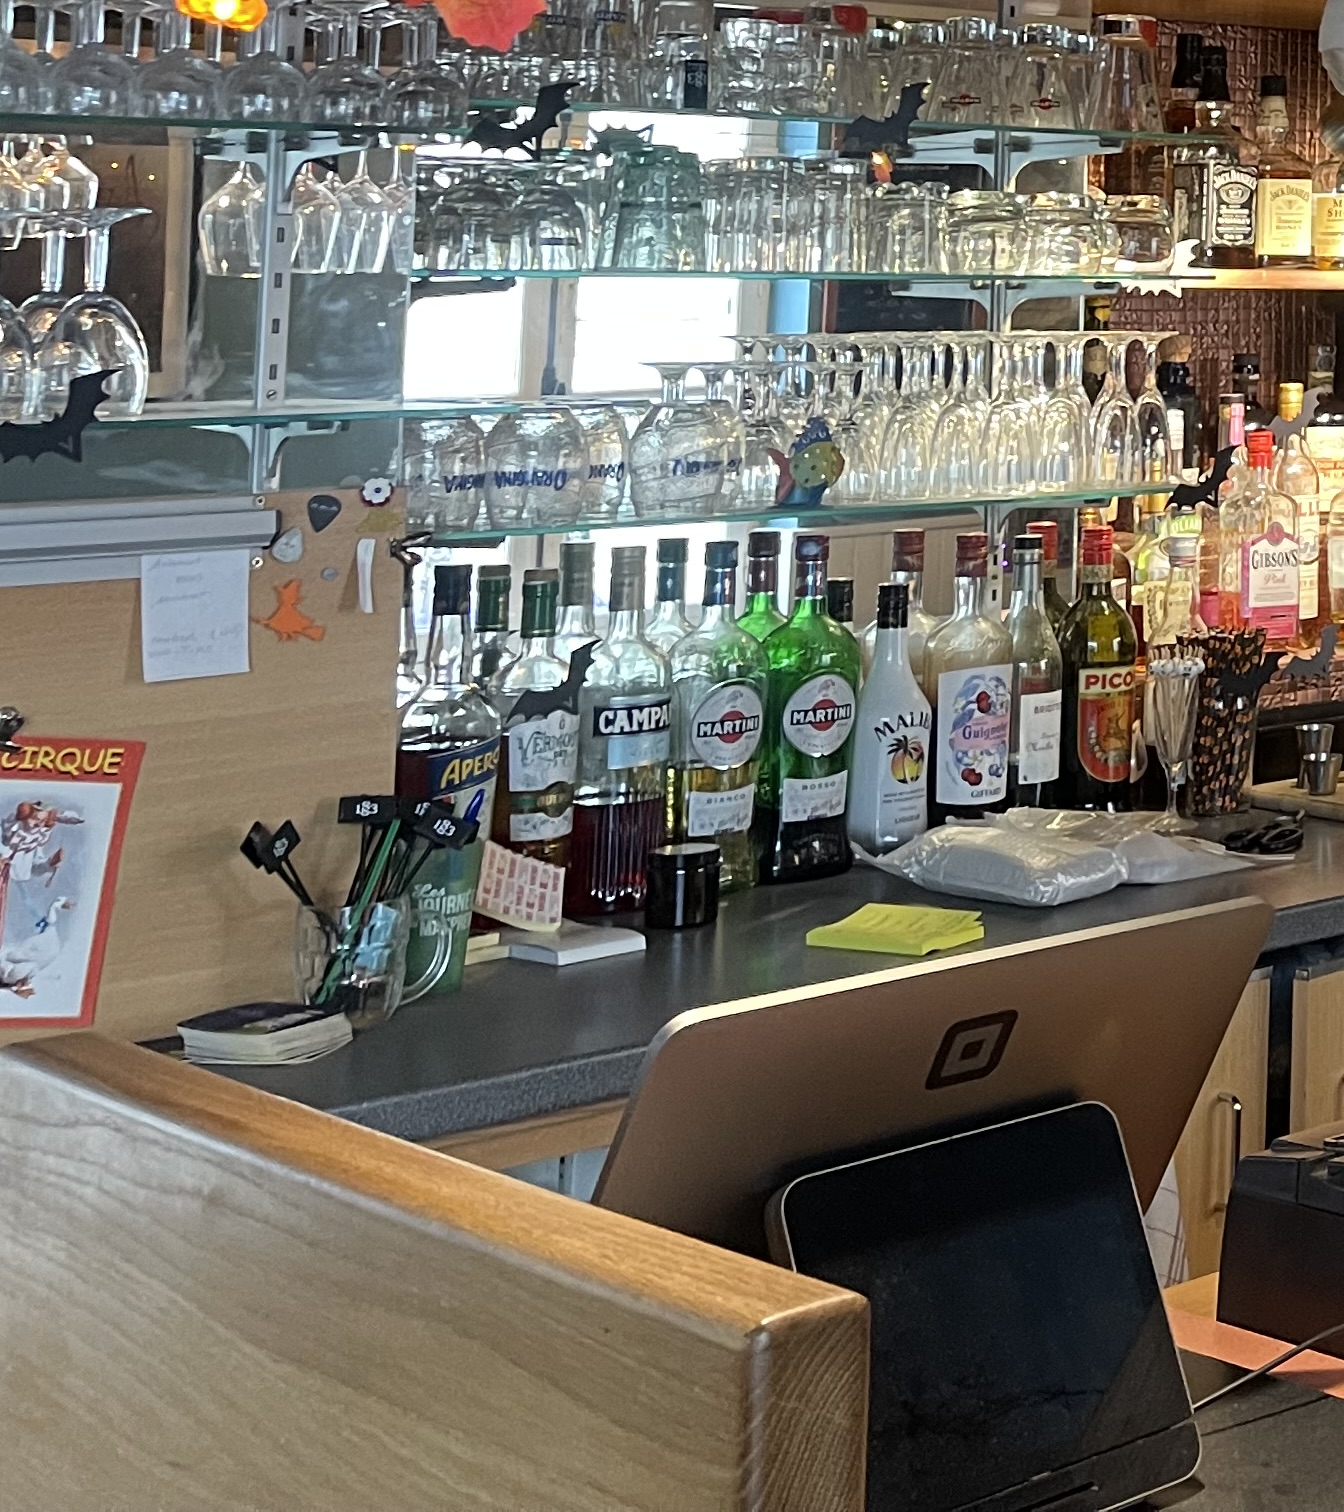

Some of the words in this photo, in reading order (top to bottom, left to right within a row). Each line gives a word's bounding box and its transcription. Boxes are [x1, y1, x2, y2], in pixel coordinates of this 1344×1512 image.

[1252, 549, 1299, 570] GIBSON'S
[793, 704, 852, 725] MARTINI
[698, 716, 760, 738] MARTINI
[355, 799, 379, 817] 183
[706, 792, 747, 806] BIANCO
[432, 818, 457, 837] 183
